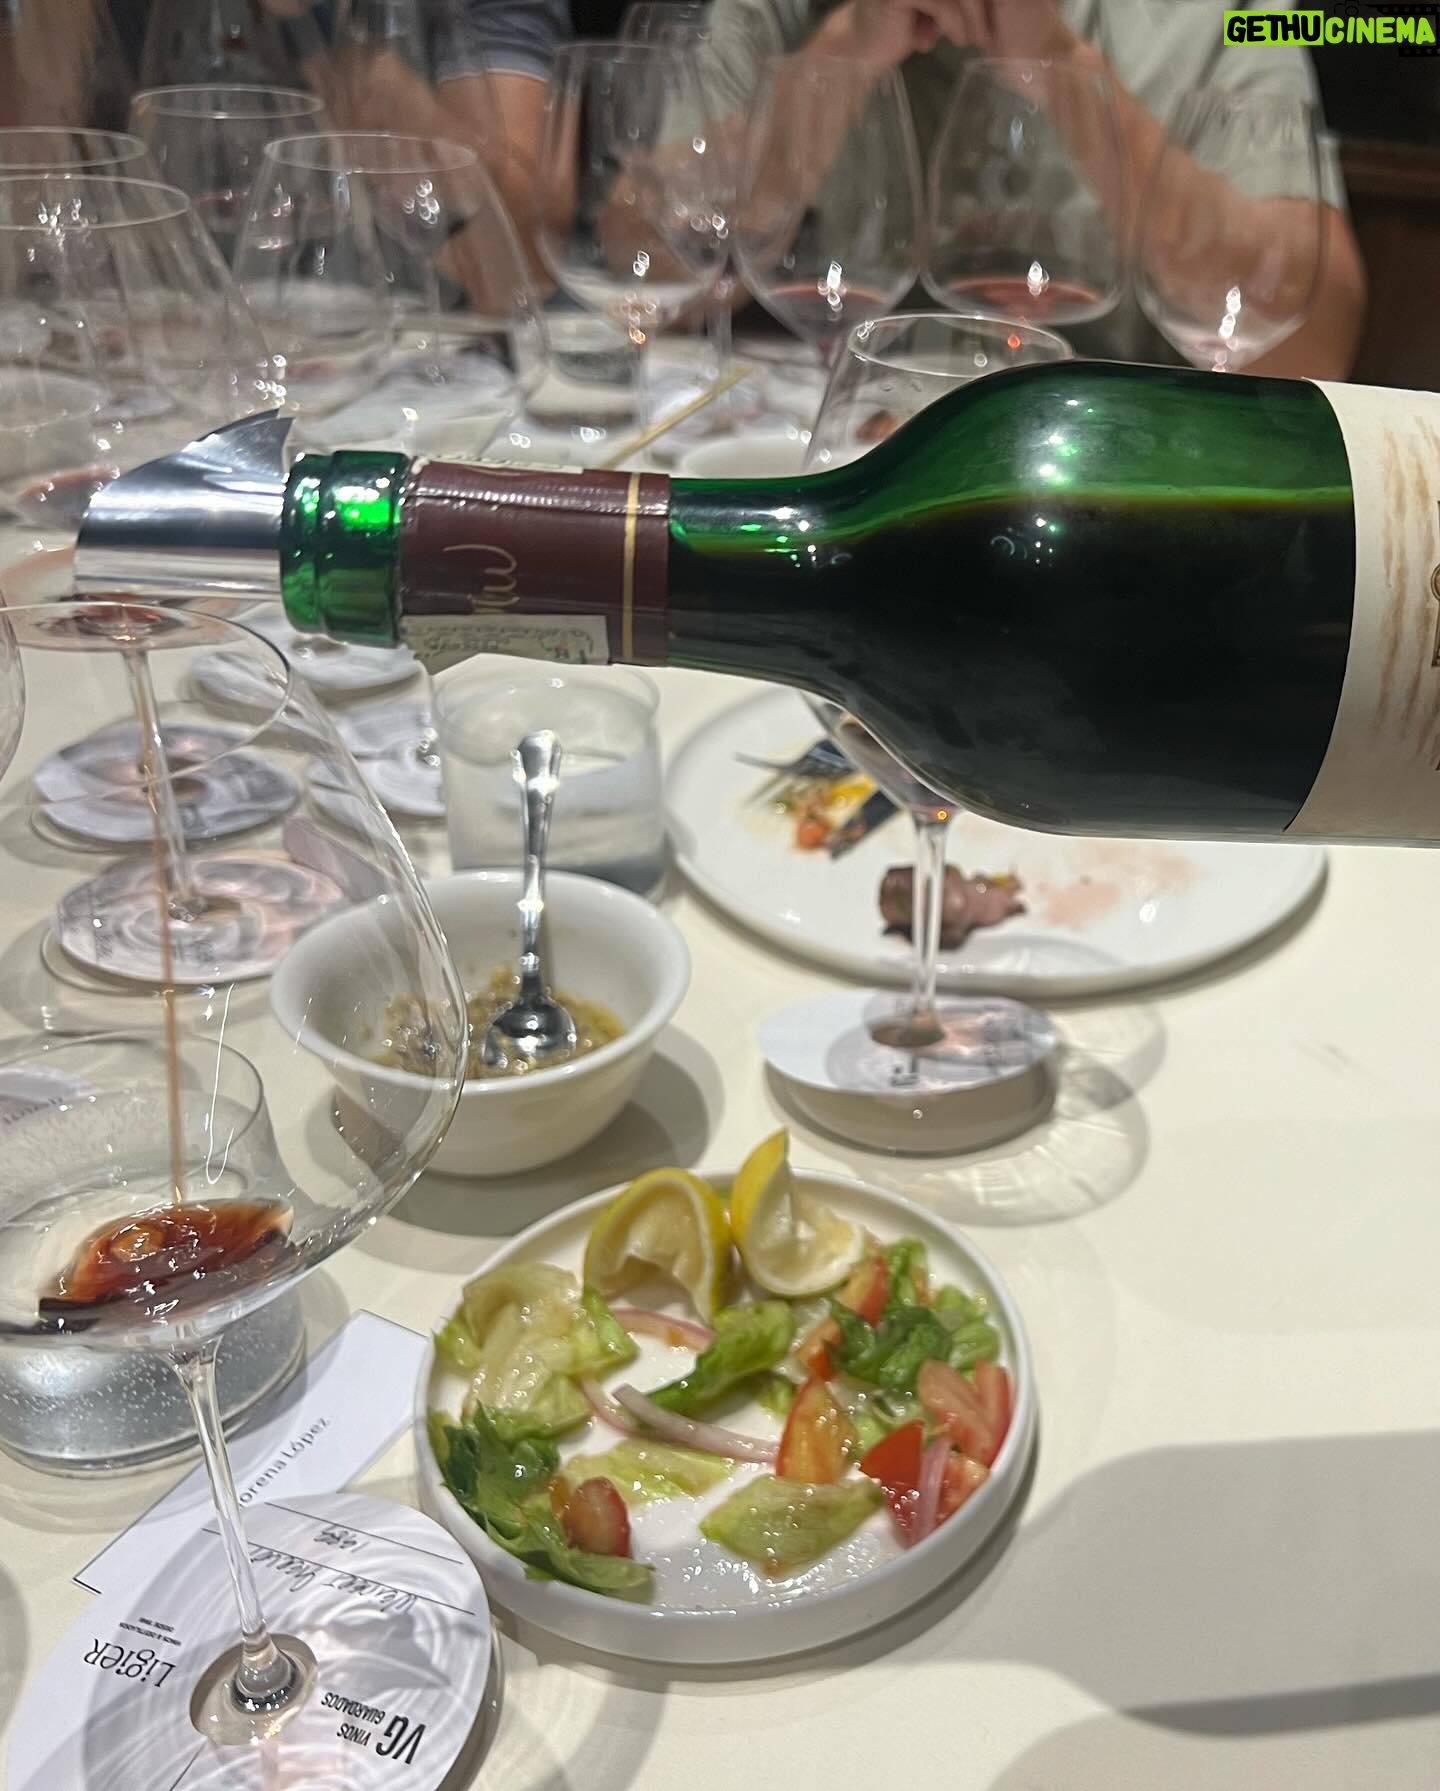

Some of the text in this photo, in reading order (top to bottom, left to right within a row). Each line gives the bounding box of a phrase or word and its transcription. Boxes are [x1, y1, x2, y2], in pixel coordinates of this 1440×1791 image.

[238, 1417, 329, 1508] orena López
[321, 1692, 385, 1724] GUARDADOS
[336, 1722, 371, 1746] VINOS
[375, 1715, 426, 1764] VG
